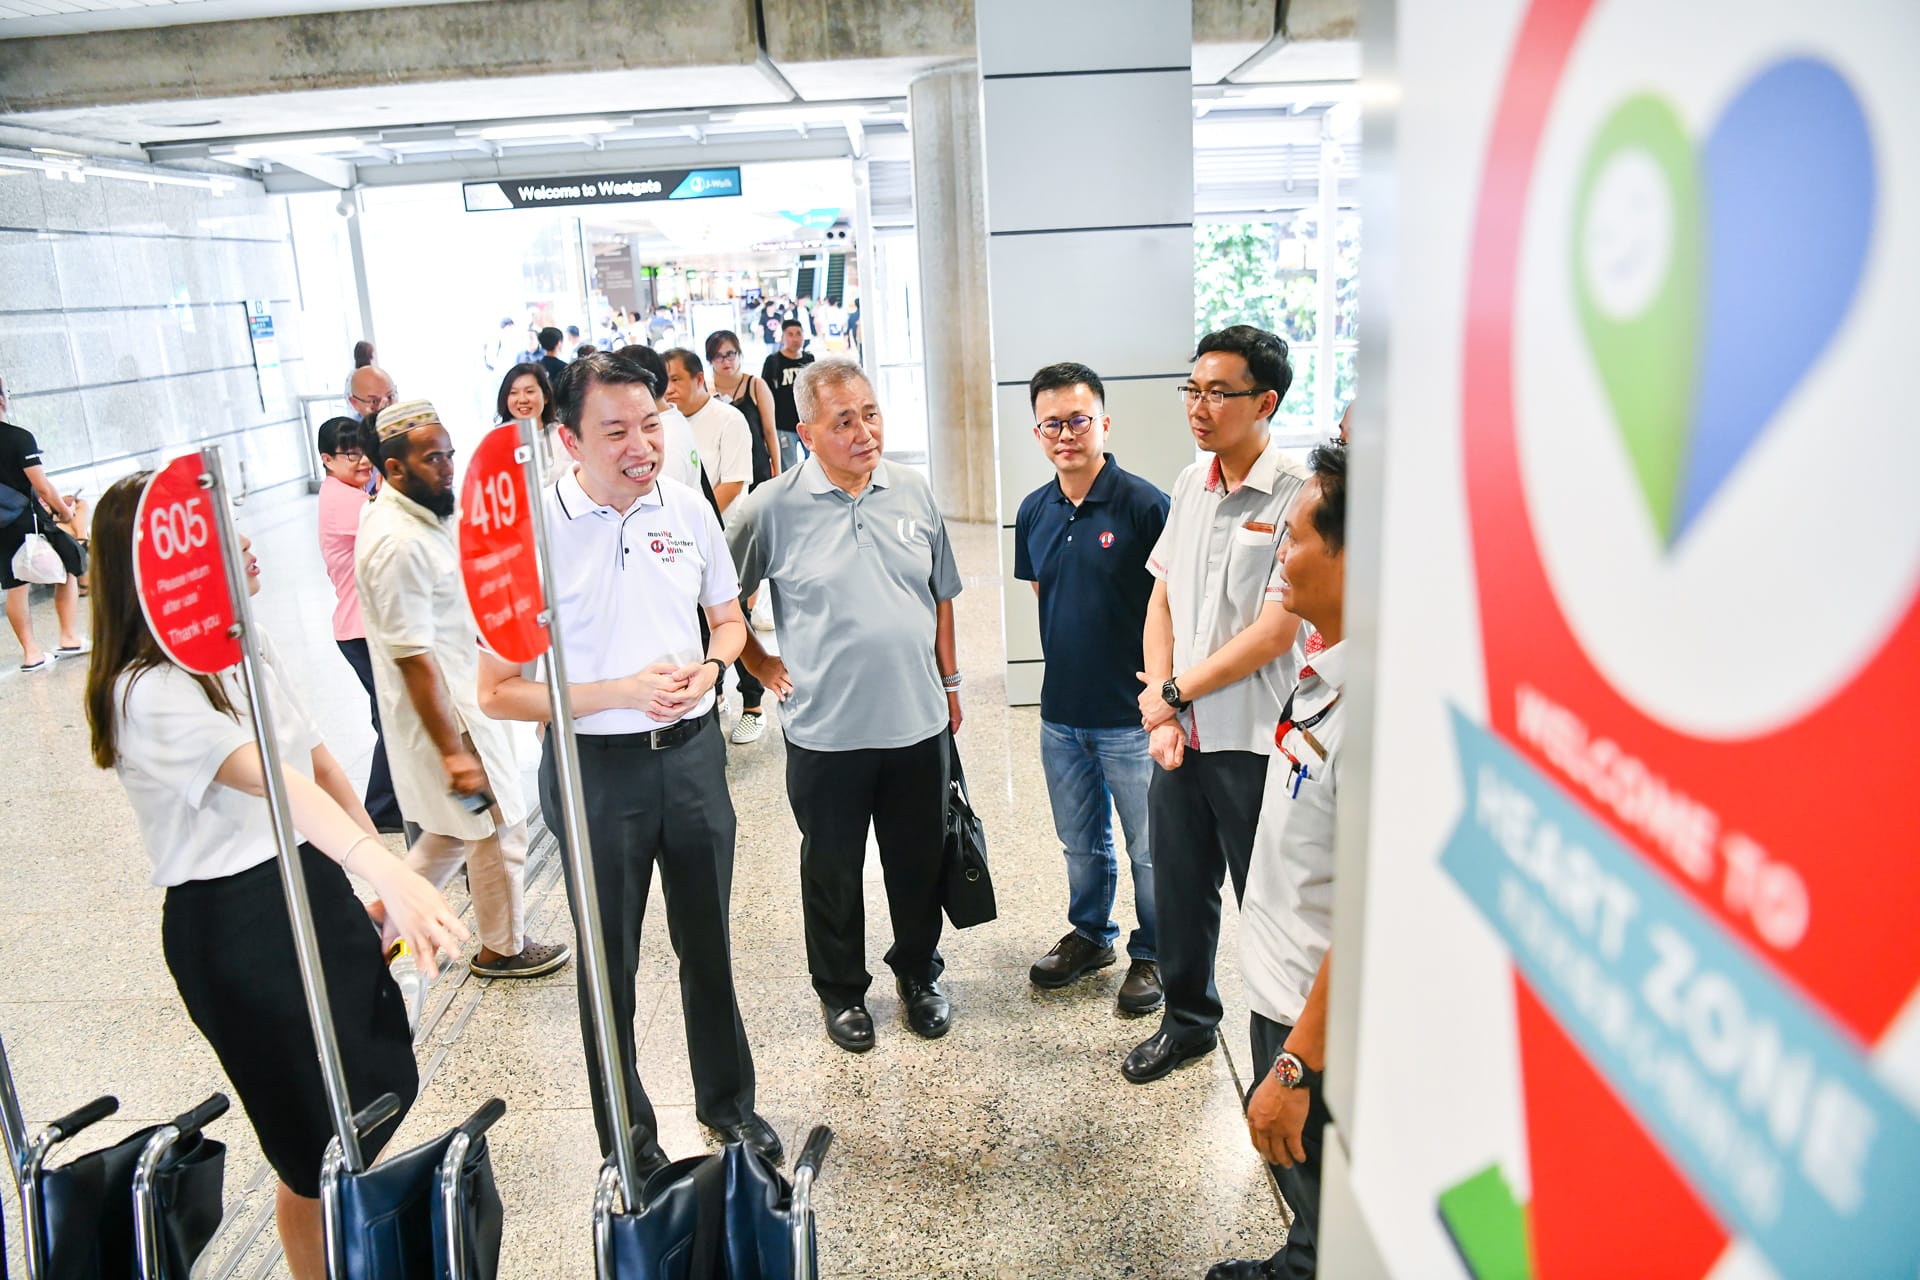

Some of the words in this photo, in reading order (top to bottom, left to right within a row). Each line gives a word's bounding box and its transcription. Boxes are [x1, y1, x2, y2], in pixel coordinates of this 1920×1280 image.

[518, 184, 581, 202] Welcome
[581, 182, 597, 198] to
[597, 178, 662, 198] Westgate
[151, 498, 208, 560] 605
[471, 471, 516, 535] 419
[157, 574, 188, 594] Please
[167, 620, 202, 647] Thank
[201, 614, 222, 636] you
[1514, 681, 1722, 882] WELCOME
[1719, 830, 1812, 949] TO
[1477, 764, 1638, 962] HEART
[1642, 920, 1878, 1218] ZONE
